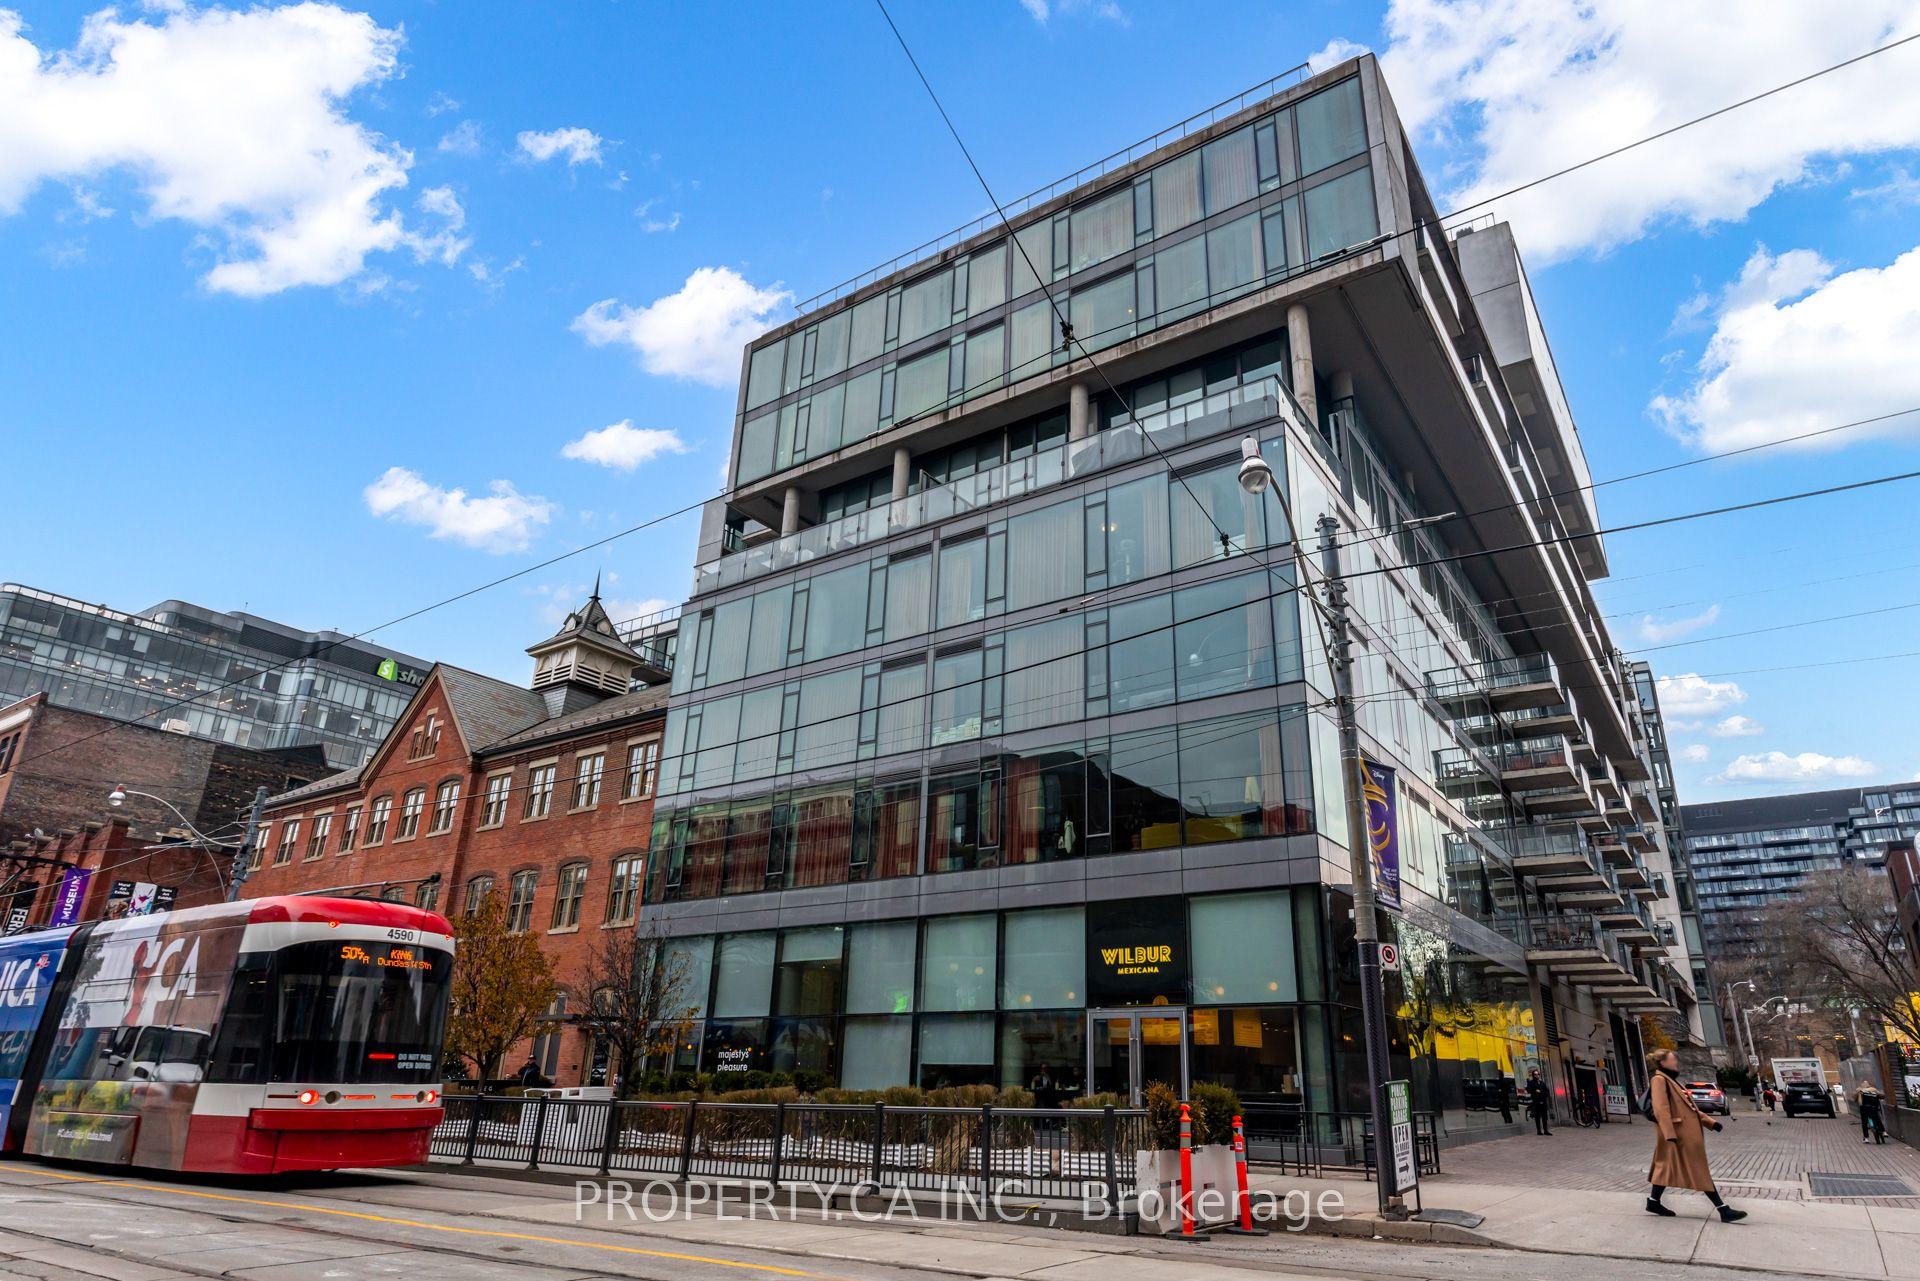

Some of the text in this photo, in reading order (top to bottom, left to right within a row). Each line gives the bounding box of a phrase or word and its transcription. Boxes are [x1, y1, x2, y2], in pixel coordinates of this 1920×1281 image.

[387, 928, 414, 942] 4590
[1101, 945, 1172, 966] WILBUR
[1117, 966, 1160, 975] MEXICANA
[717, 1060, 748, 1073] pleasure
[1393, 1125, 1409, 1145] OPEN
